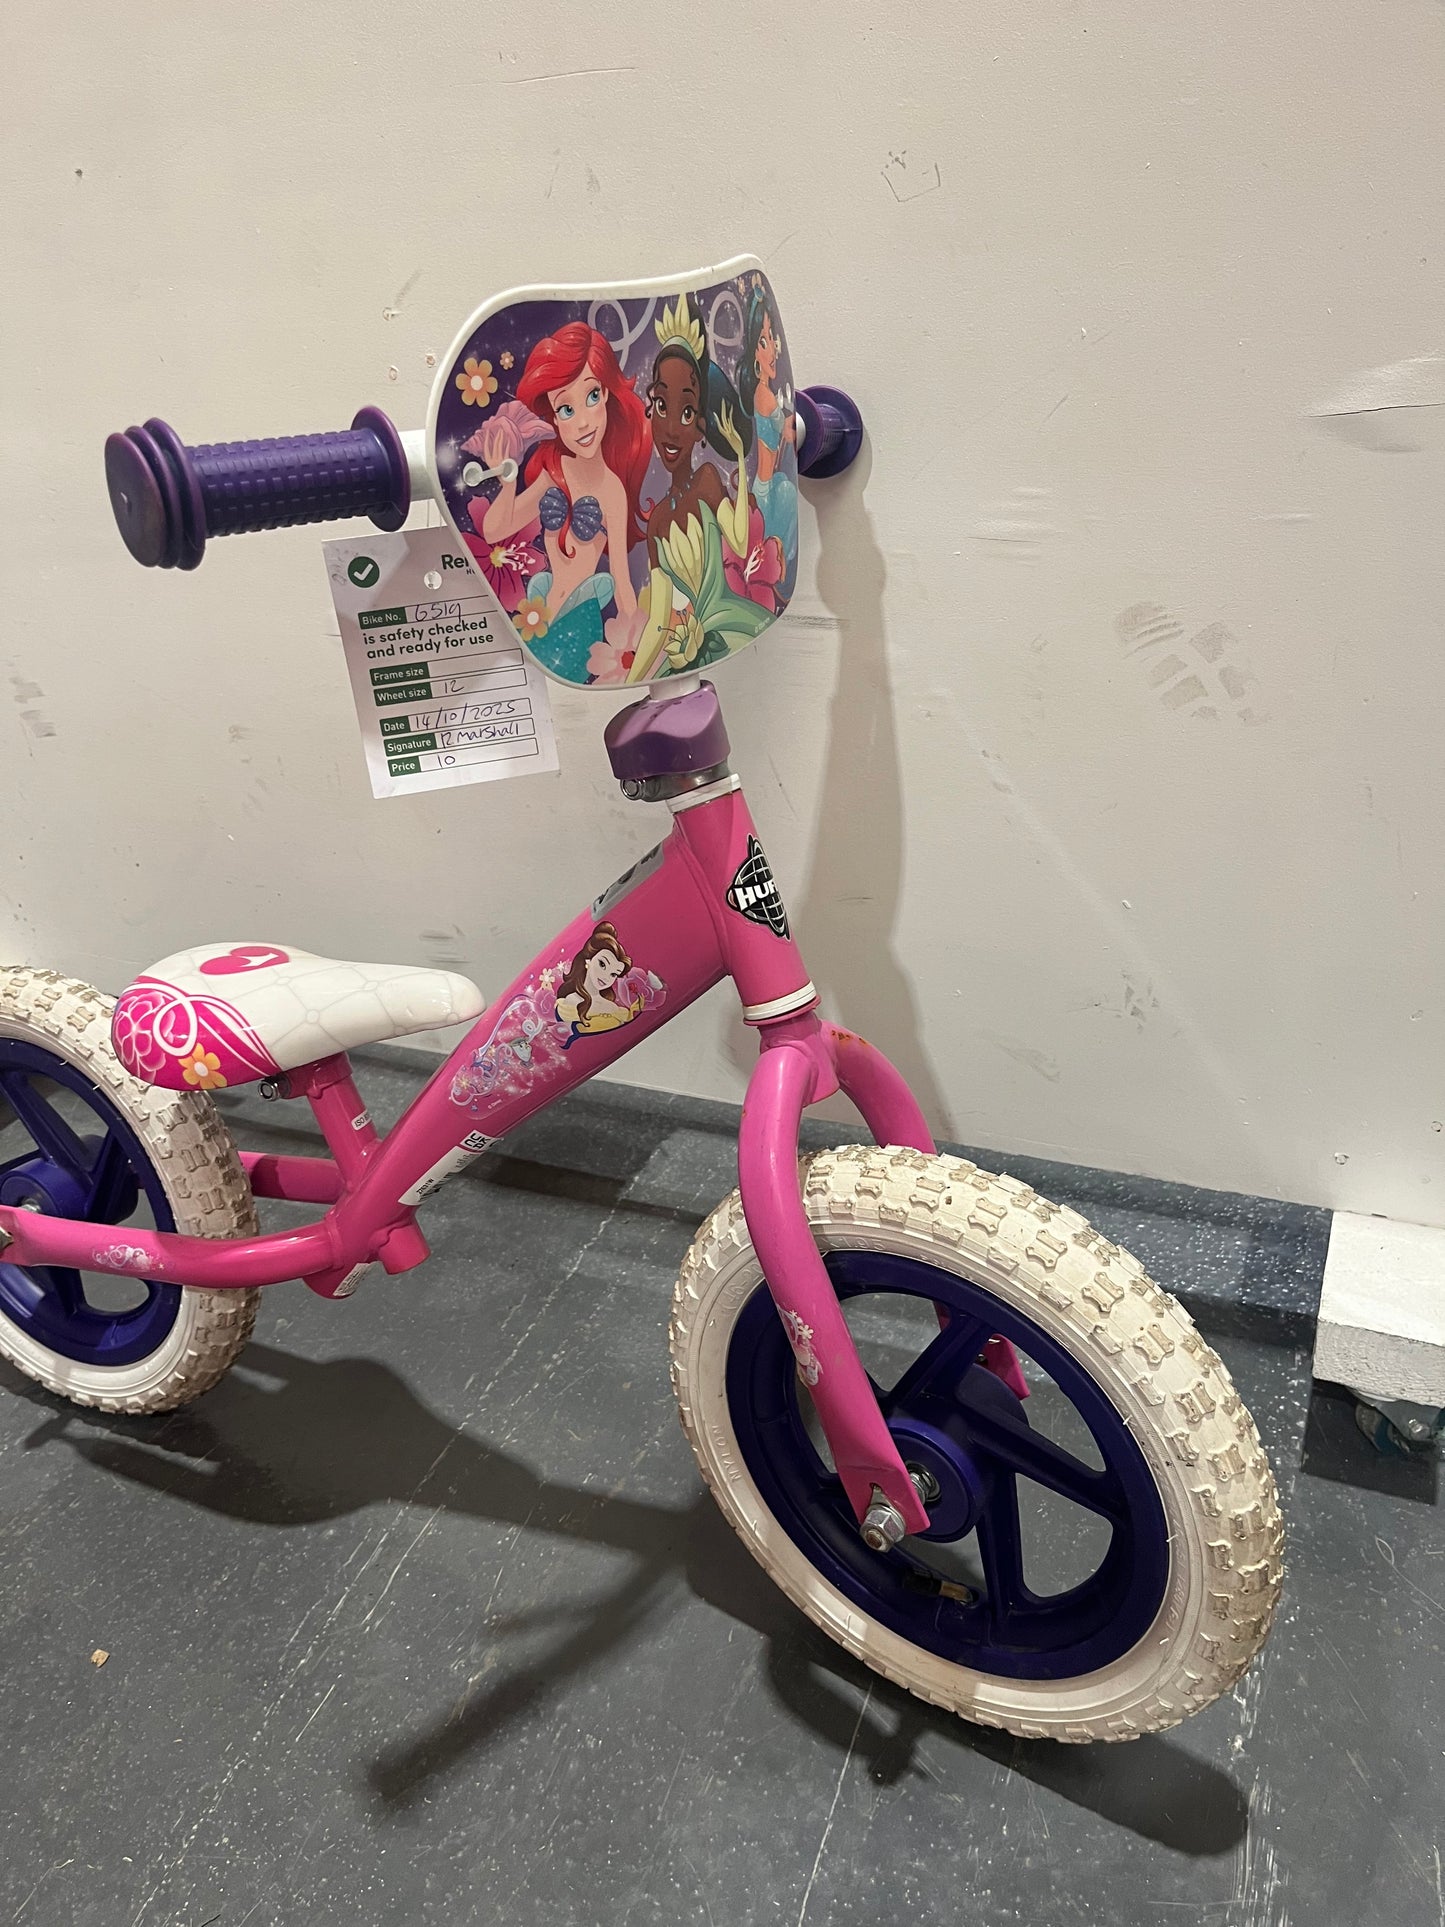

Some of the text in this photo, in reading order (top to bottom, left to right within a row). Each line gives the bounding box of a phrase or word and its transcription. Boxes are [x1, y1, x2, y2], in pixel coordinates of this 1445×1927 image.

[362, 613, 401, 625] Bike No.
[362, 616, 488, 645] is safety checked
[366, 634, 494, 659] and ready for use
[373, 667, 424, 682] Frame size
[444, 679, 465, 694] 12
[376, 688, 427, 702] Wheel size
[383, 721, 405, 732] Date
[387, 738, 432, 753] Signature
[391, 761, 416, 773] Price
[437, 754, 456, 768] 10
